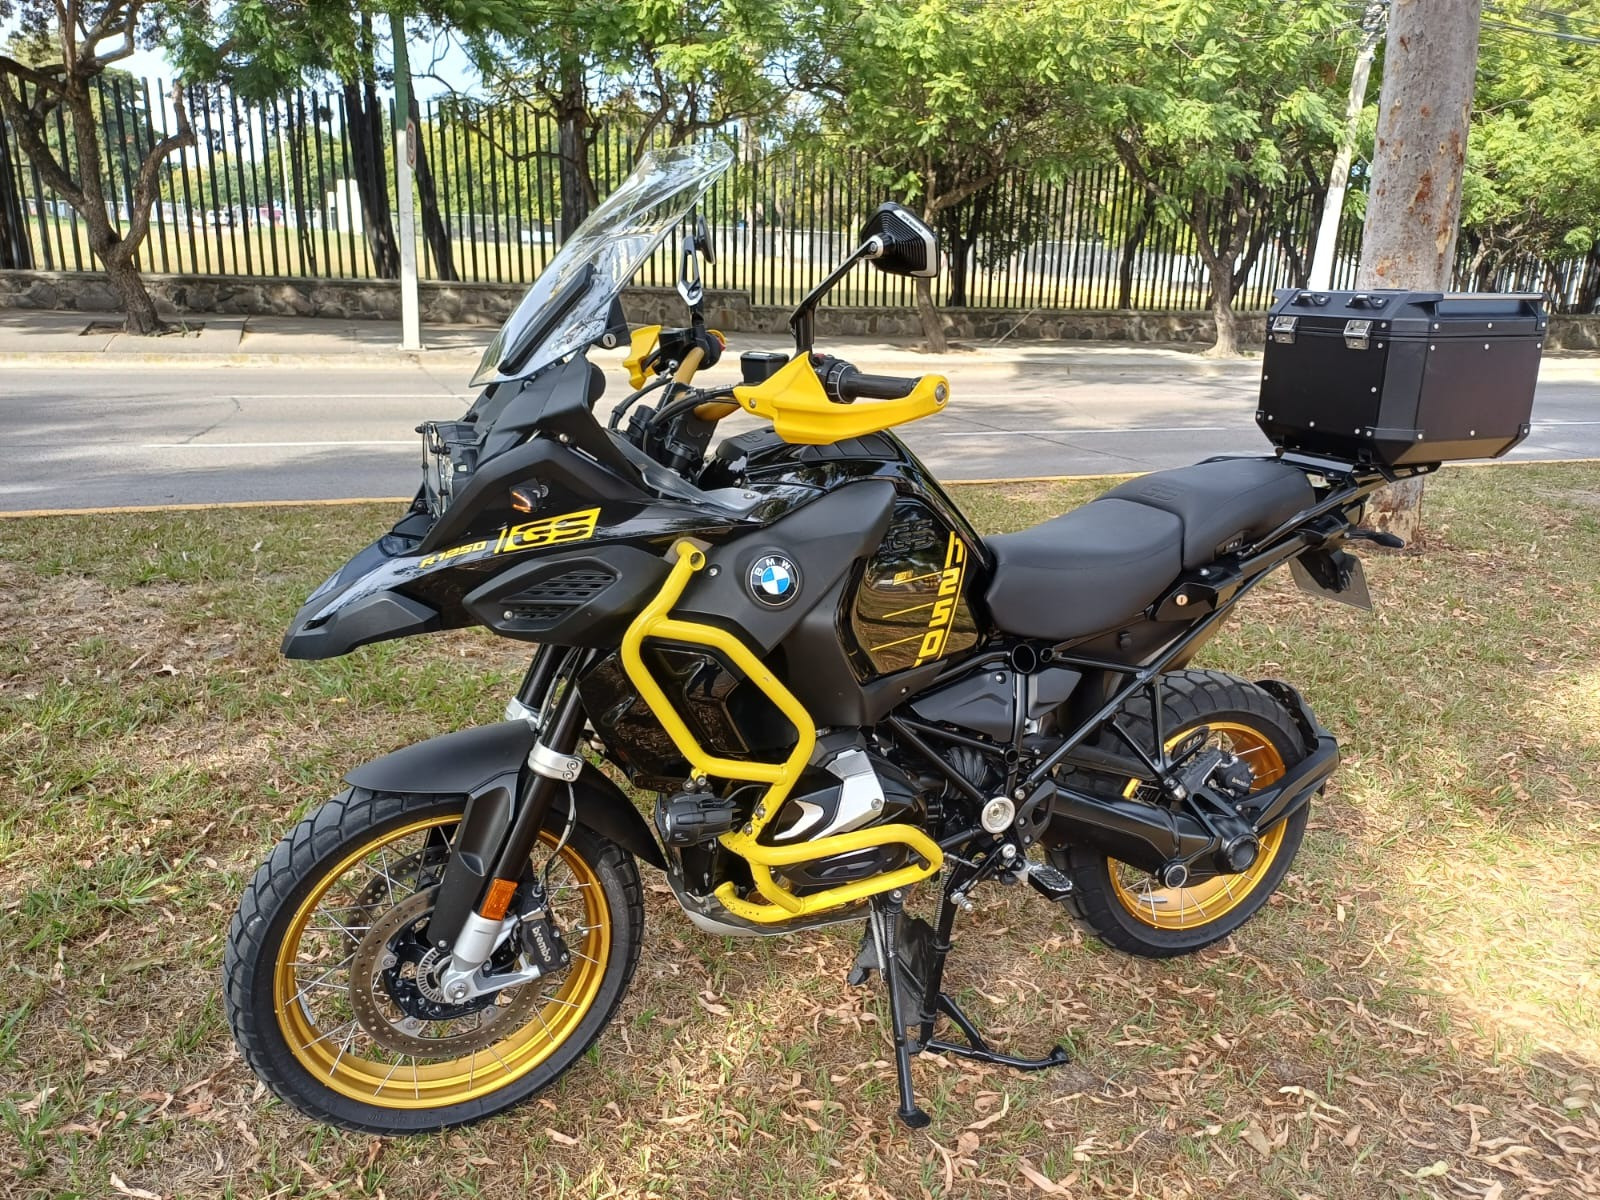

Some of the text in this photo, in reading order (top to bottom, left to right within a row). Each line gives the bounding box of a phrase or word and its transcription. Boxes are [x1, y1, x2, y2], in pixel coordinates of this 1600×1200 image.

[510, 511, 595, 549] GS
[754, 557, 791, 577] BMW
[918, 537, 965, 659] 1250
[531, 925, 552, 962] brembo
